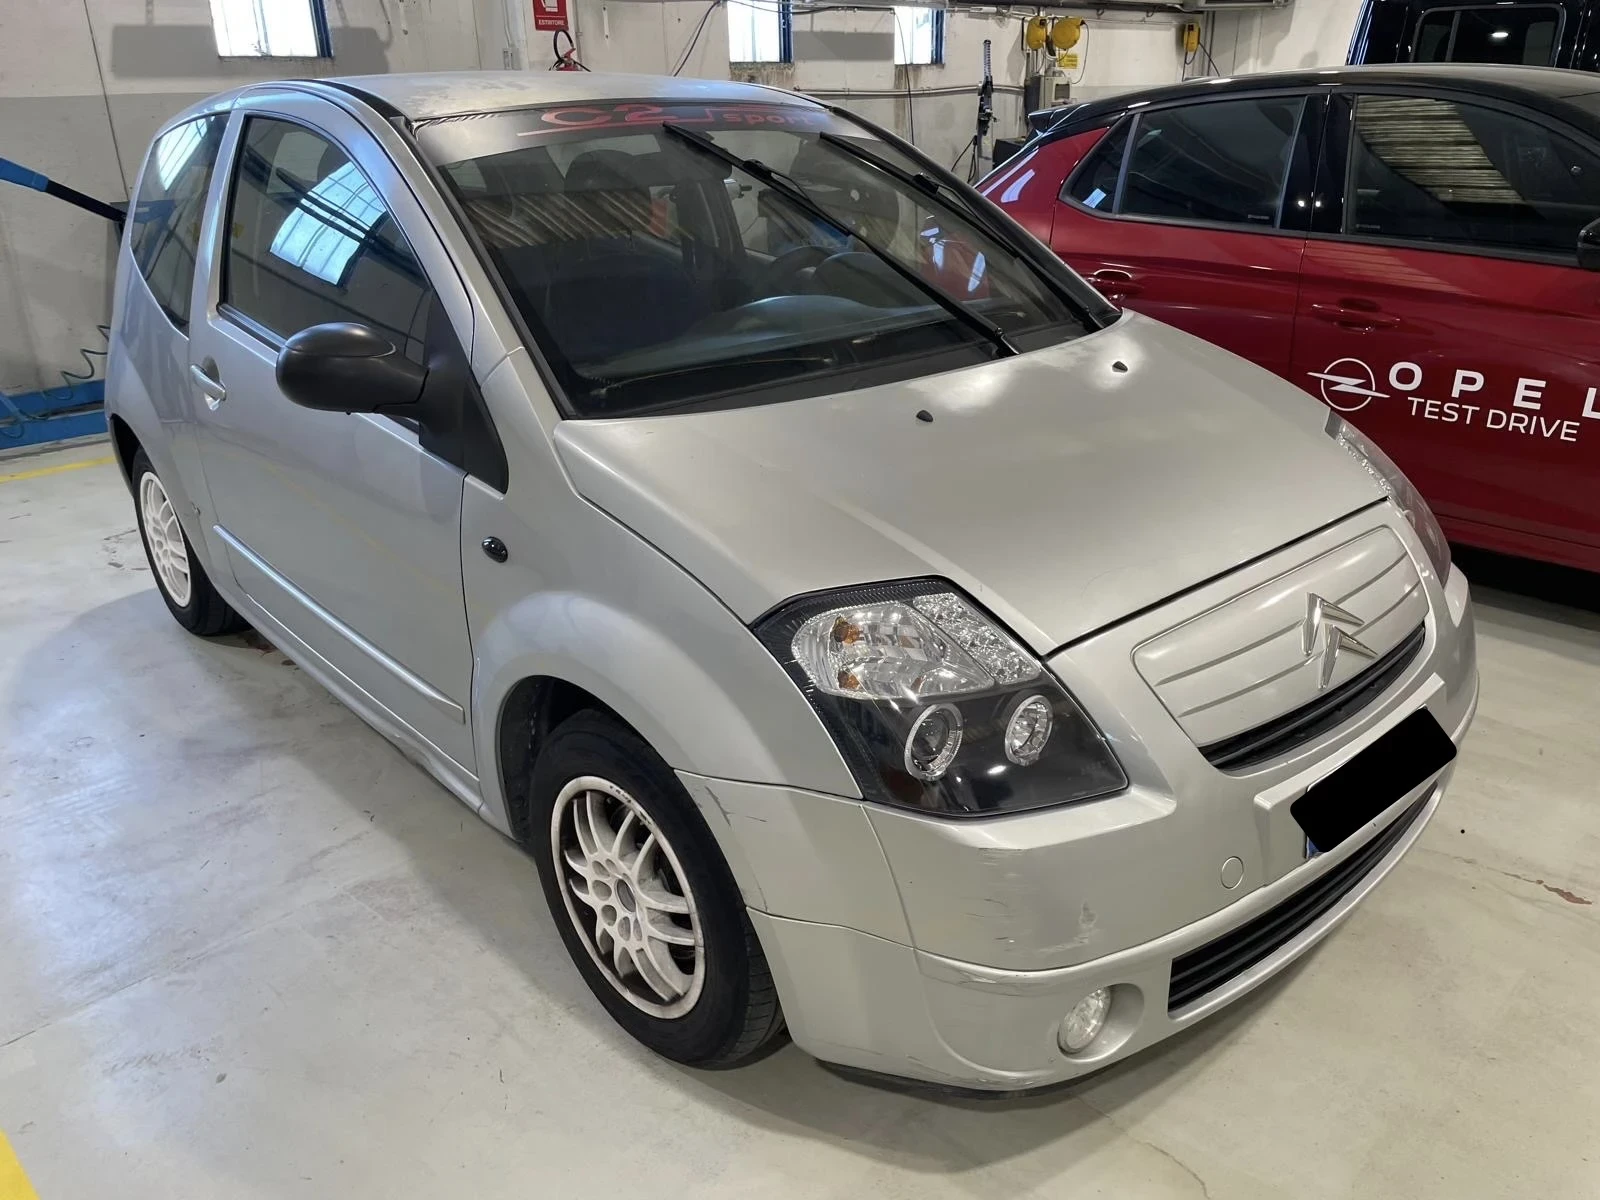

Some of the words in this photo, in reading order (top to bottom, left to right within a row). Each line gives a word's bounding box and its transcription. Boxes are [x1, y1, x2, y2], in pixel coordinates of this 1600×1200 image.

[1388, 361, 1600, 420] OPEL
[1407, 396, 1480, 425] TEST
[1486, 409, 1580, 442] DRIVE
